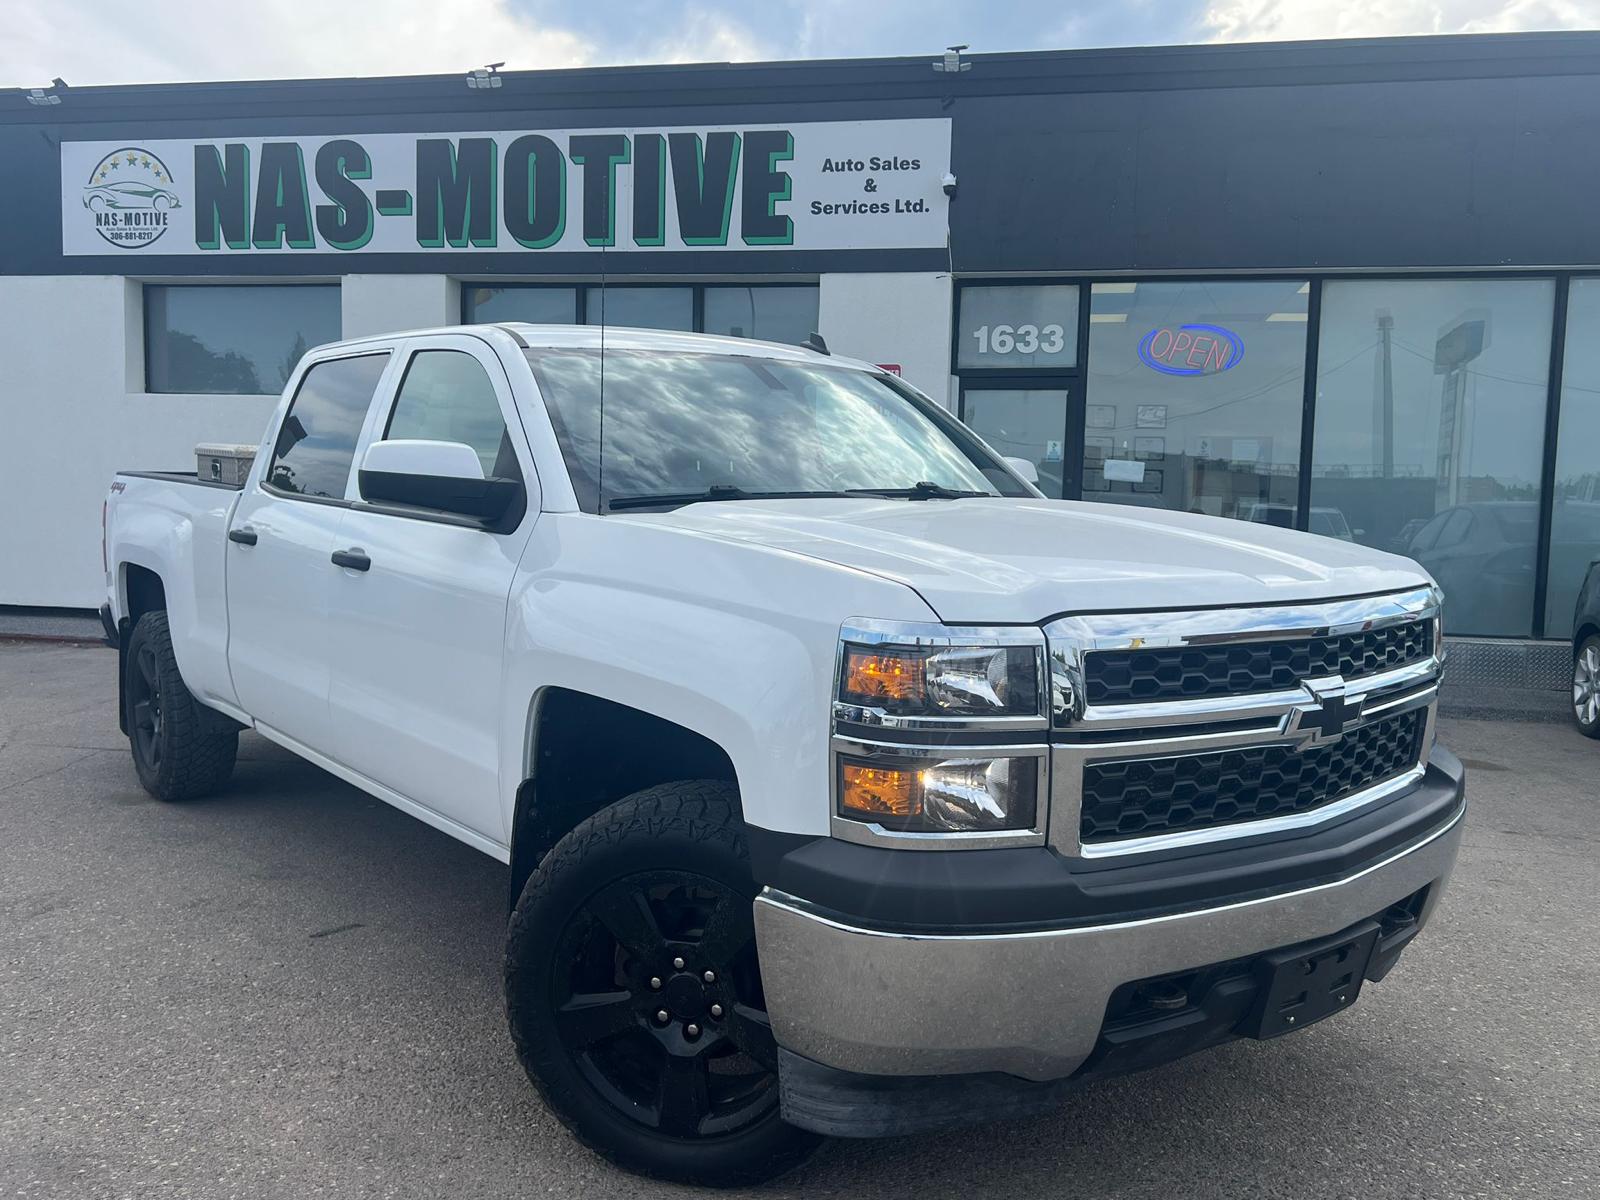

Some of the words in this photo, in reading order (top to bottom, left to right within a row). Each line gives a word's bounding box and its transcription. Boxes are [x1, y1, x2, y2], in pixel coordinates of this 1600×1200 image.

[822, 158, 865, 172] Auto
[869, 156, 921, 171] Sales
[195, 130, 794, 250] NAS-MOTIVE
[864, 178, 877, 192] &
[811, 200, 890, 215] Services
[895, 199, 930, 213] Ltd.
[96, 212, 168, 226] NAS-MOTIVE
[973, 324, 1064, 354] 1633
[1150, 328, 1229, 370] OPEN
